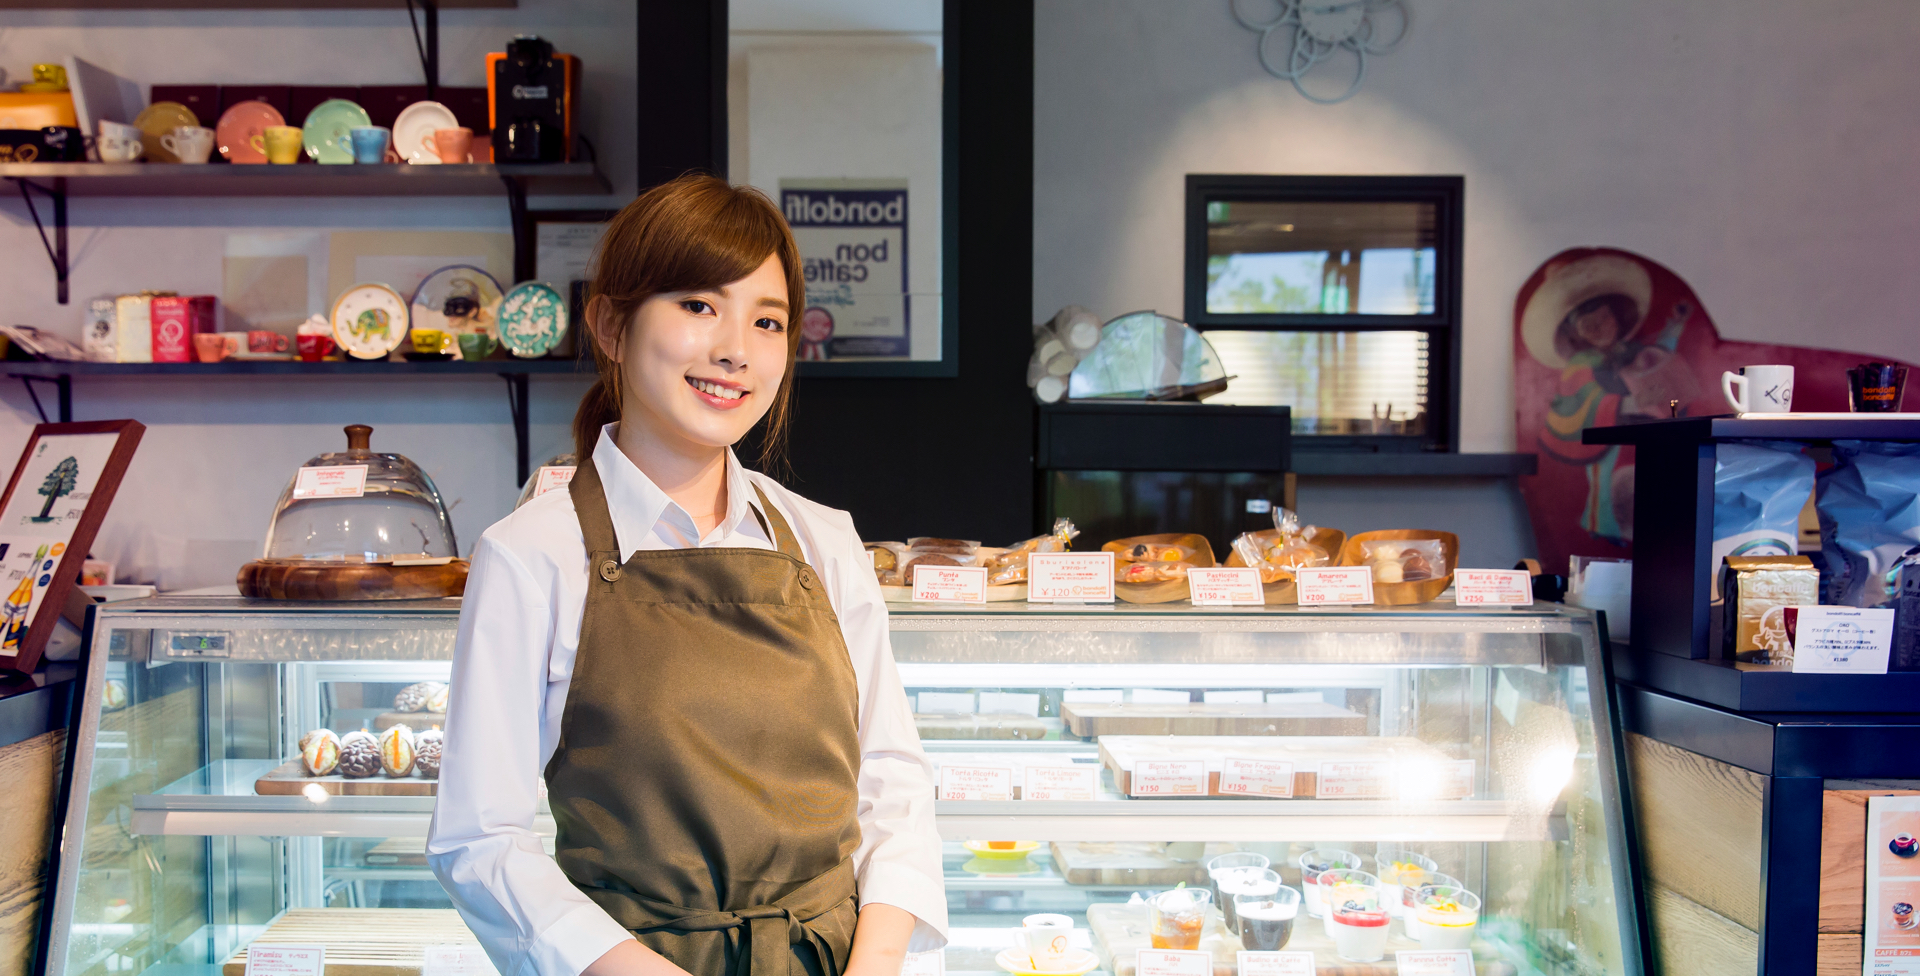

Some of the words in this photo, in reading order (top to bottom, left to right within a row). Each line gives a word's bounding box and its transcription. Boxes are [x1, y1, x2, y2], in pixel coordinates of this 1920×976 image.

[200, 638, 208, 649] 6
[1752, 657, 1793, 665] bondo
[973, 770, 999, 778] Ricotta
[1035, 769, 1055, 777] Torta
[1228, 783, 1247, 791] ¥150
[946, 792, 966, 800] ¥200
[253, 950, 282, 958] Tiramisu
